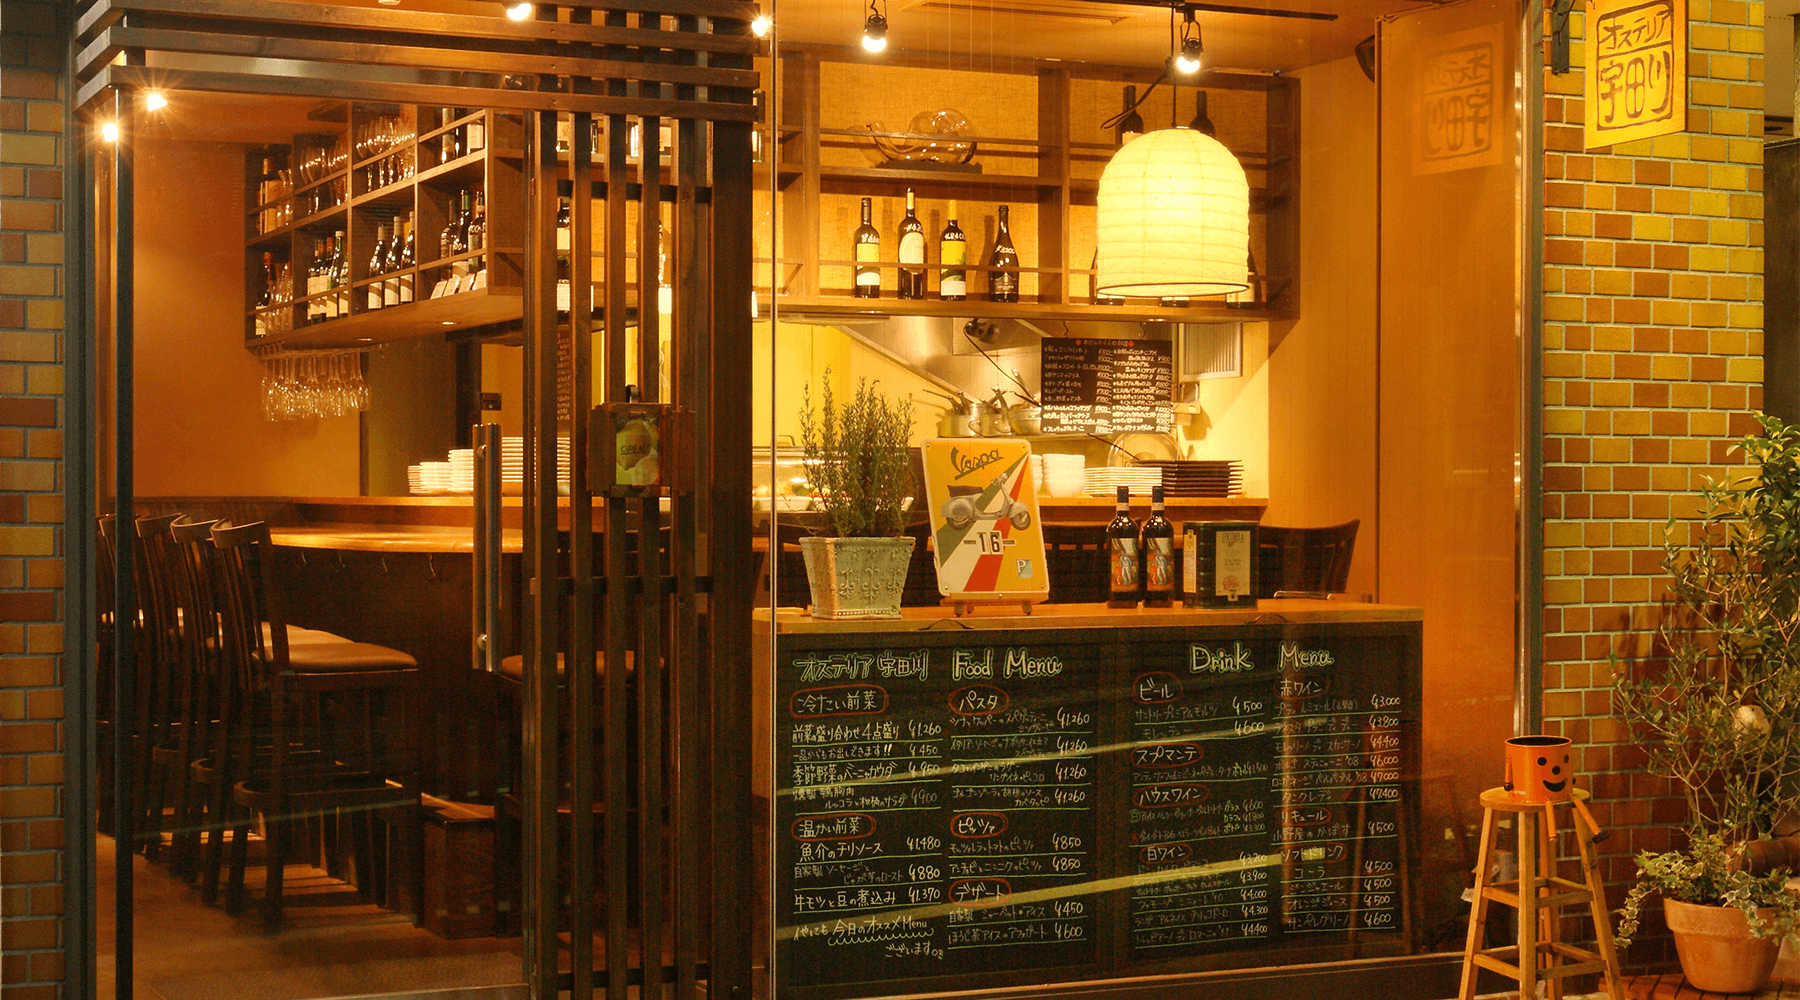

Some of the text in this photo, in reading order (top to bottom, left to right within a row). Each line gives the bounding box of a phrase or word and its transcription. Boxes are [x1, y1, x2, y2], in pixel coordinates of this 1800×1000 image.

[1599, 9, 1670, 49] オステリア
[1600, 51, 1671, 124] 宇田川
[951, 447, 1004, 481] Vespa
[793, 649, 929, 682] オステリア 宇田川
[952, 647, 1062, 681] Food Menu
[1190, 641, 1334, 673] Drink Menu
[1140, 677, 1174, 700] ビール
[1280, 678, 1322, 697] 赤ワイン
[798, 690, 877, 713] 冷たい前菜
[959, 690, 998, 711] パスタ
[1136, 746, 1197, 765] スプマンテ
[1140, 787, 1200, 805] ハウスワイン
[958, 817, 996, 834] ピッツァ
[1282, 810, 1327, 823] リキュール
[799, 816, 861, 837] 温かい前菜
[1368, 821, 1394, 835] ¥500
[1053, 833, 1081, 851] ¥850
[908, 864, 940, 881] ¥880
[1053, 856, 1081, 872] ¥850
[1295, 861, 1393, 879] コーラ ¥500
[955, 882, 1004, 902] デザート
[1364, 879, 1392, 891] ¥500
[1054, 901, 1083, 917] ¥450
[1364, 895, 1391, 907] ¥500
[1364, 912, 1391, 927] ¥600
[1055, 922, 1083, 939] ¥600
